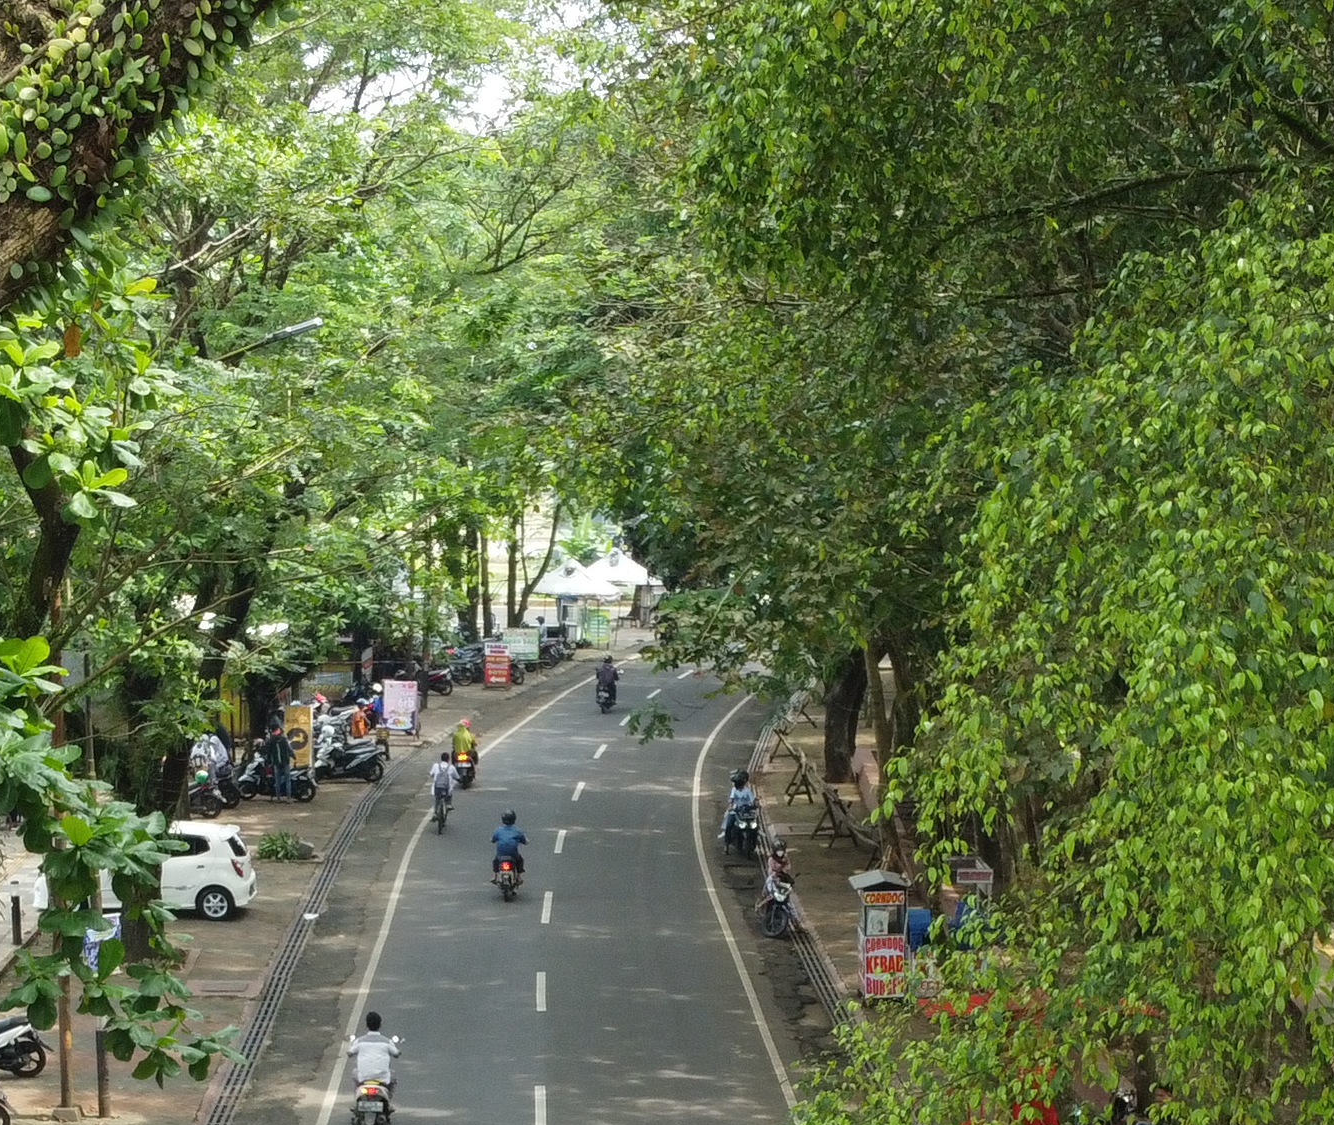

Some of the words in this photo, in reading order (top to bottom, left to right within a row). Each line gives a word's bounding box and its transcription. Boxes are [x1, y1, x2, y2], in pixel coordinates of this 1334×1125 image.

[865, 892, 904, 904] CORNDOG
[866, 937, 904, 953] CORNDOG
[866, 955, 904, 973] KEBAB
